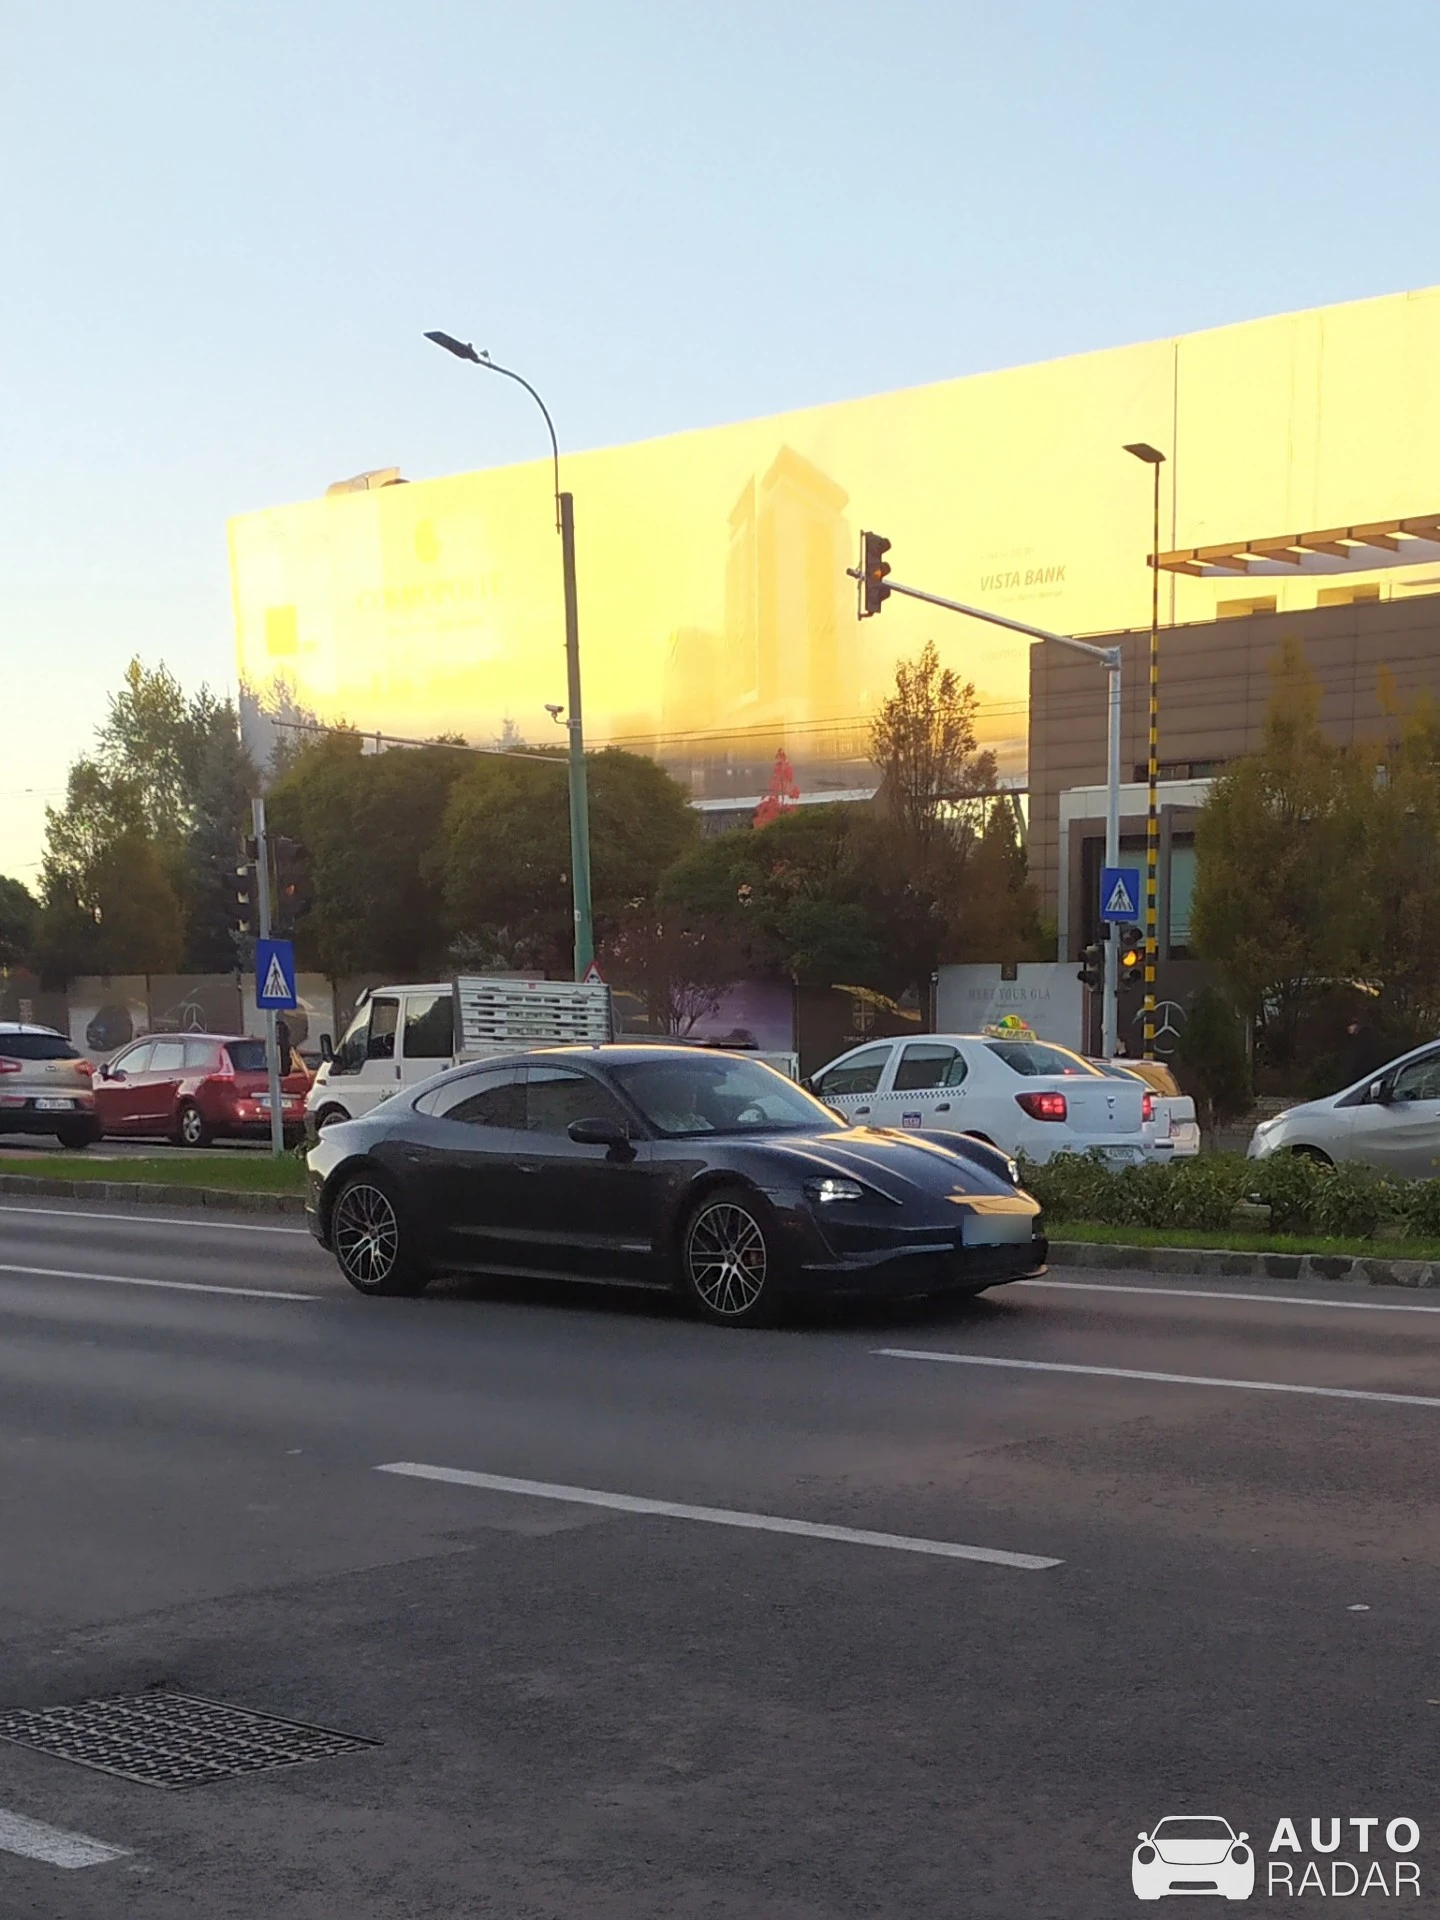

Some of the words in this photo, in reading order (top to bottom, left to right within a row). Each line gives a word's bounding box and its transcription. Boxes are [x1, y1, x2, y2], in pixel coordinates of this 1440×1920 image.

[980, 571, 1020, 592] VISTA
[1024, 564, 1066, 586] BANK
[968, 988, 994, 1000] MEET
[999, 988, 1027, 1000] YOUR
[1030, 988, 1051, 1000] GLA
